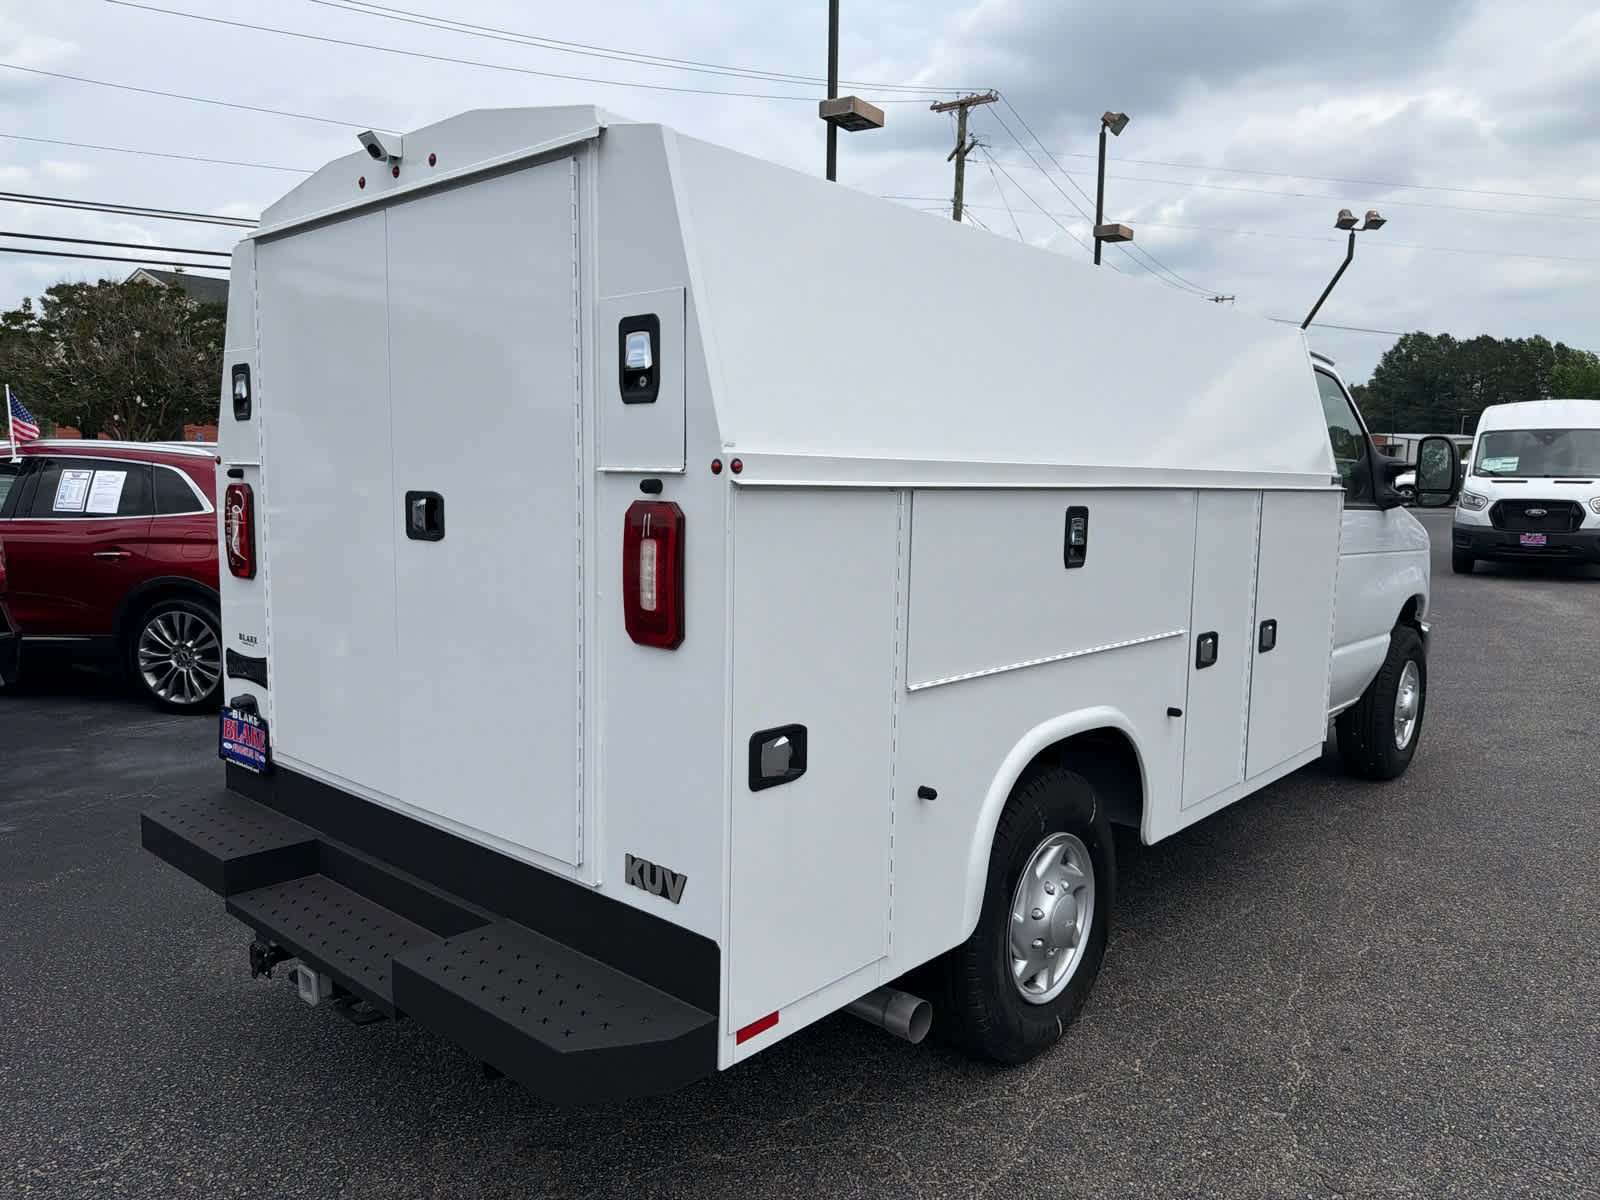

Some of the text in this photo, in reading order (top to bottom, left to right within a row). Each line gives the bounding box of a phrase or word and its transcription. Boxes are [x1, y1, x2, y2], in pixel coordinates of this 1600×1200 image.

[239, 633, 257, 644] BLAKE
[232, 710, 258, 726] BLAKE
[224, 718, 265, 752] BLAKE
[625, 853, 688, 904] KUV
